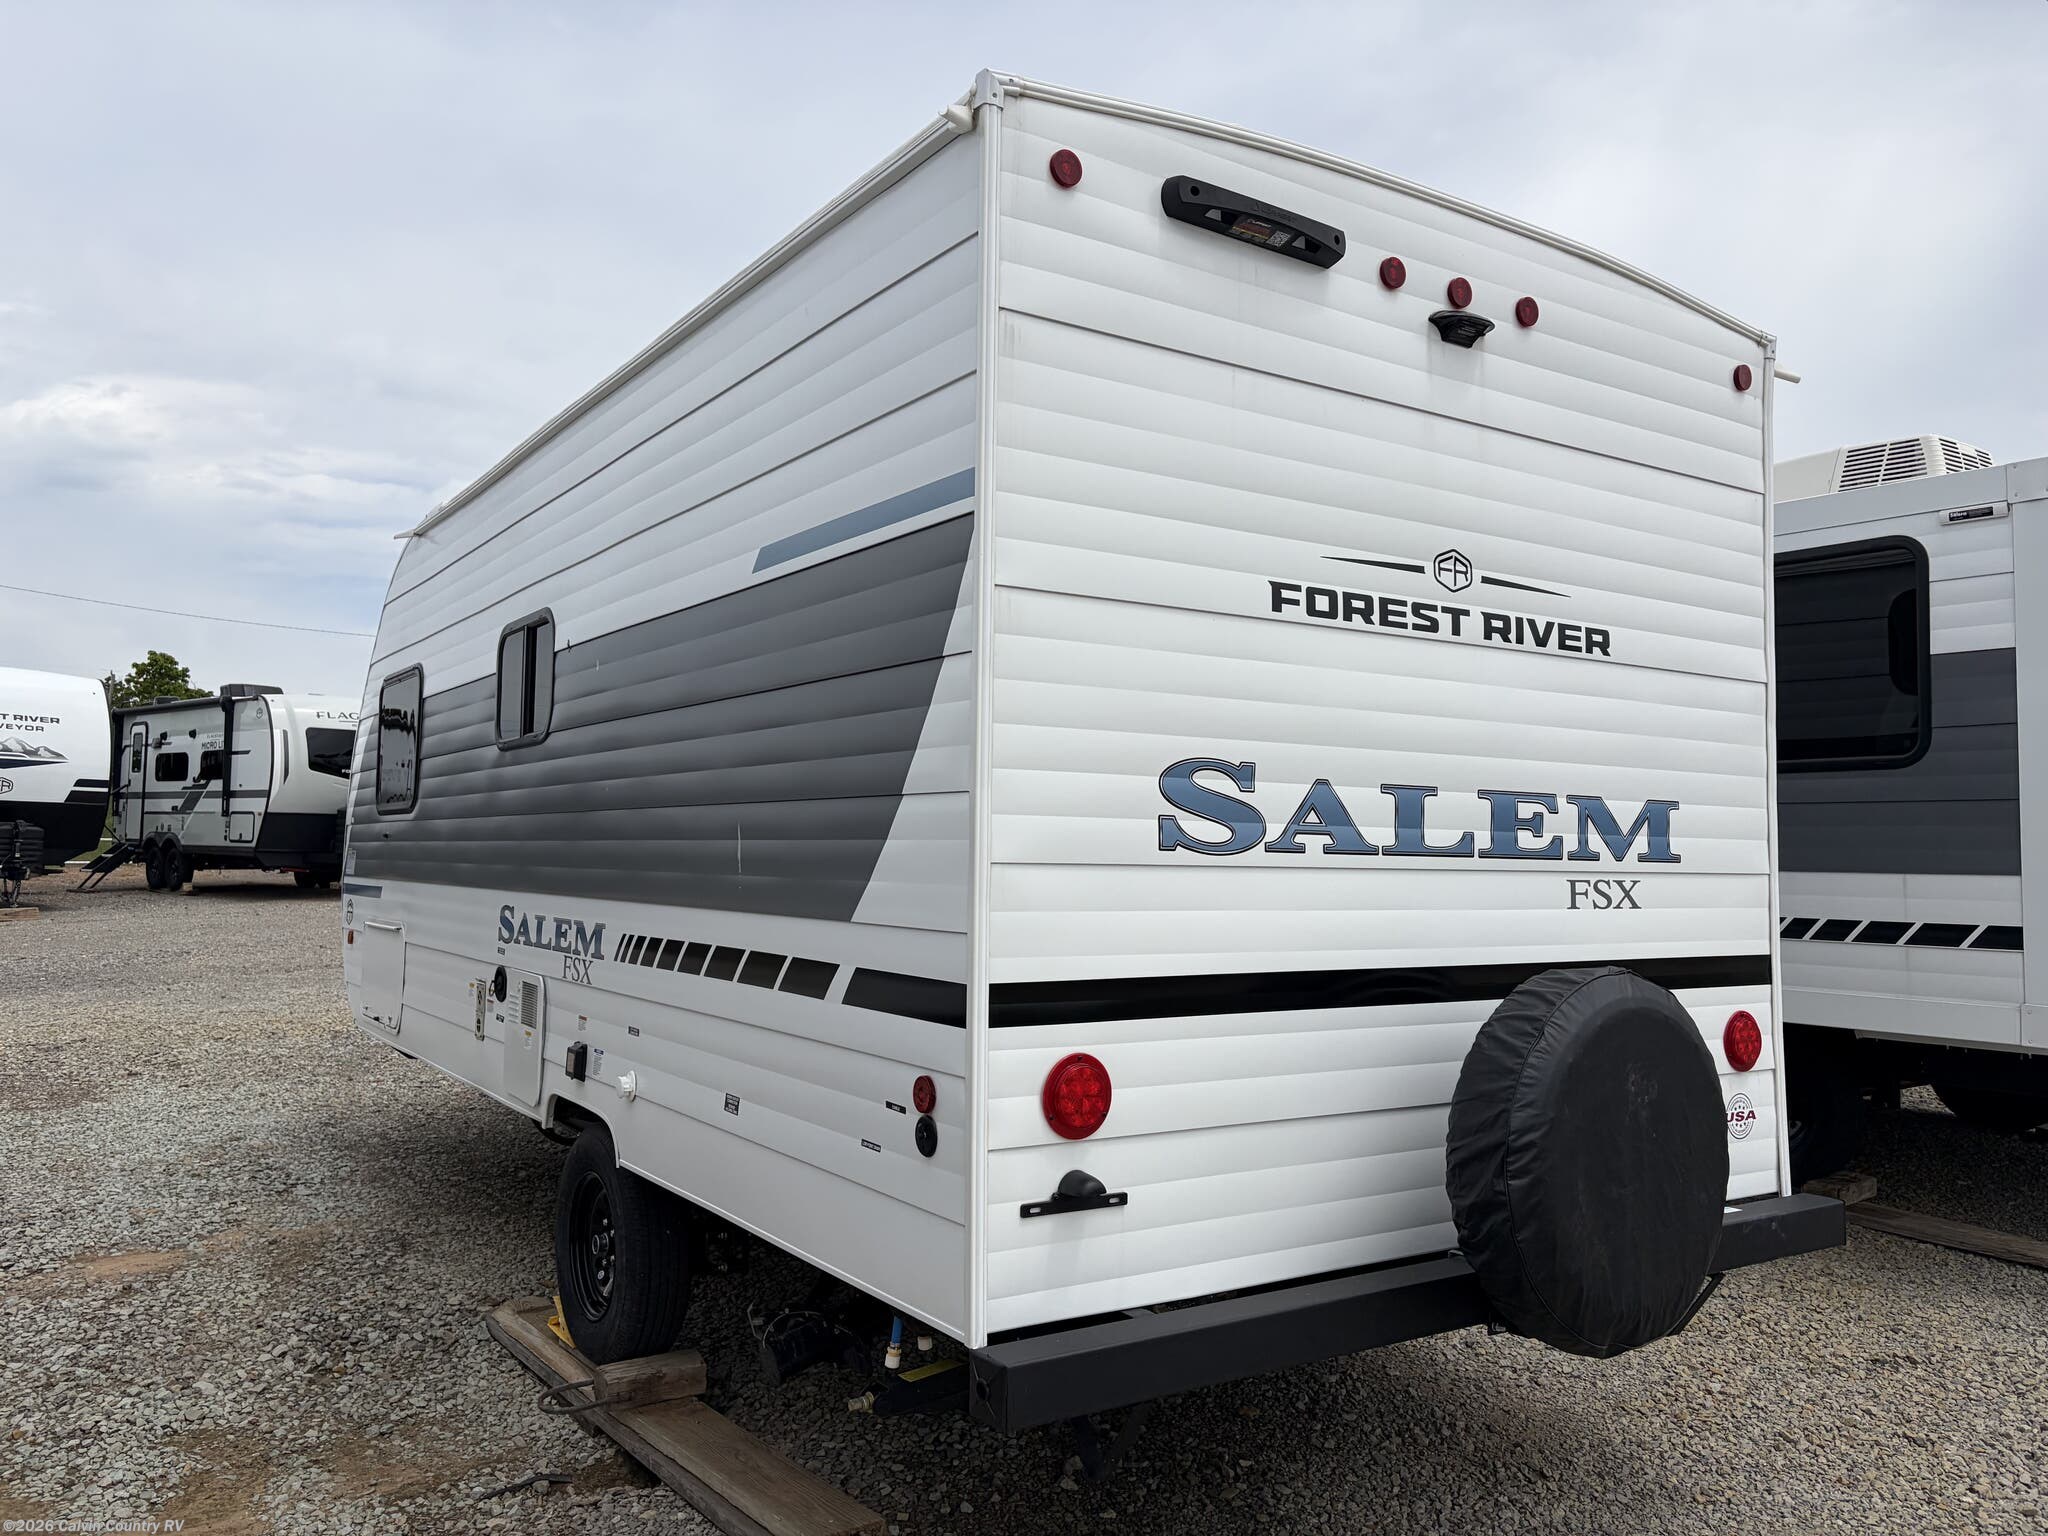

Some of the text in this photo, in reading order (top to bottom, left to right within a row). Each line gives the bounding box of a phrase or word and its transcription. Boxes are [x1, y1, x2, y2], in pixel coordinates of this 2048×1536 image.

[1268, 580, 1611, 657] FOREST RIVER
[13, 713, 60, 725] RIVER
[1158, 757, 1681, 863] SALEM
[1567, 879, 1642, 910] FSX
[498, 904, 606, 960] SALEM
[562, 955, 593, 985] FSX
[1726, 1110, 1757, 1123] USA
